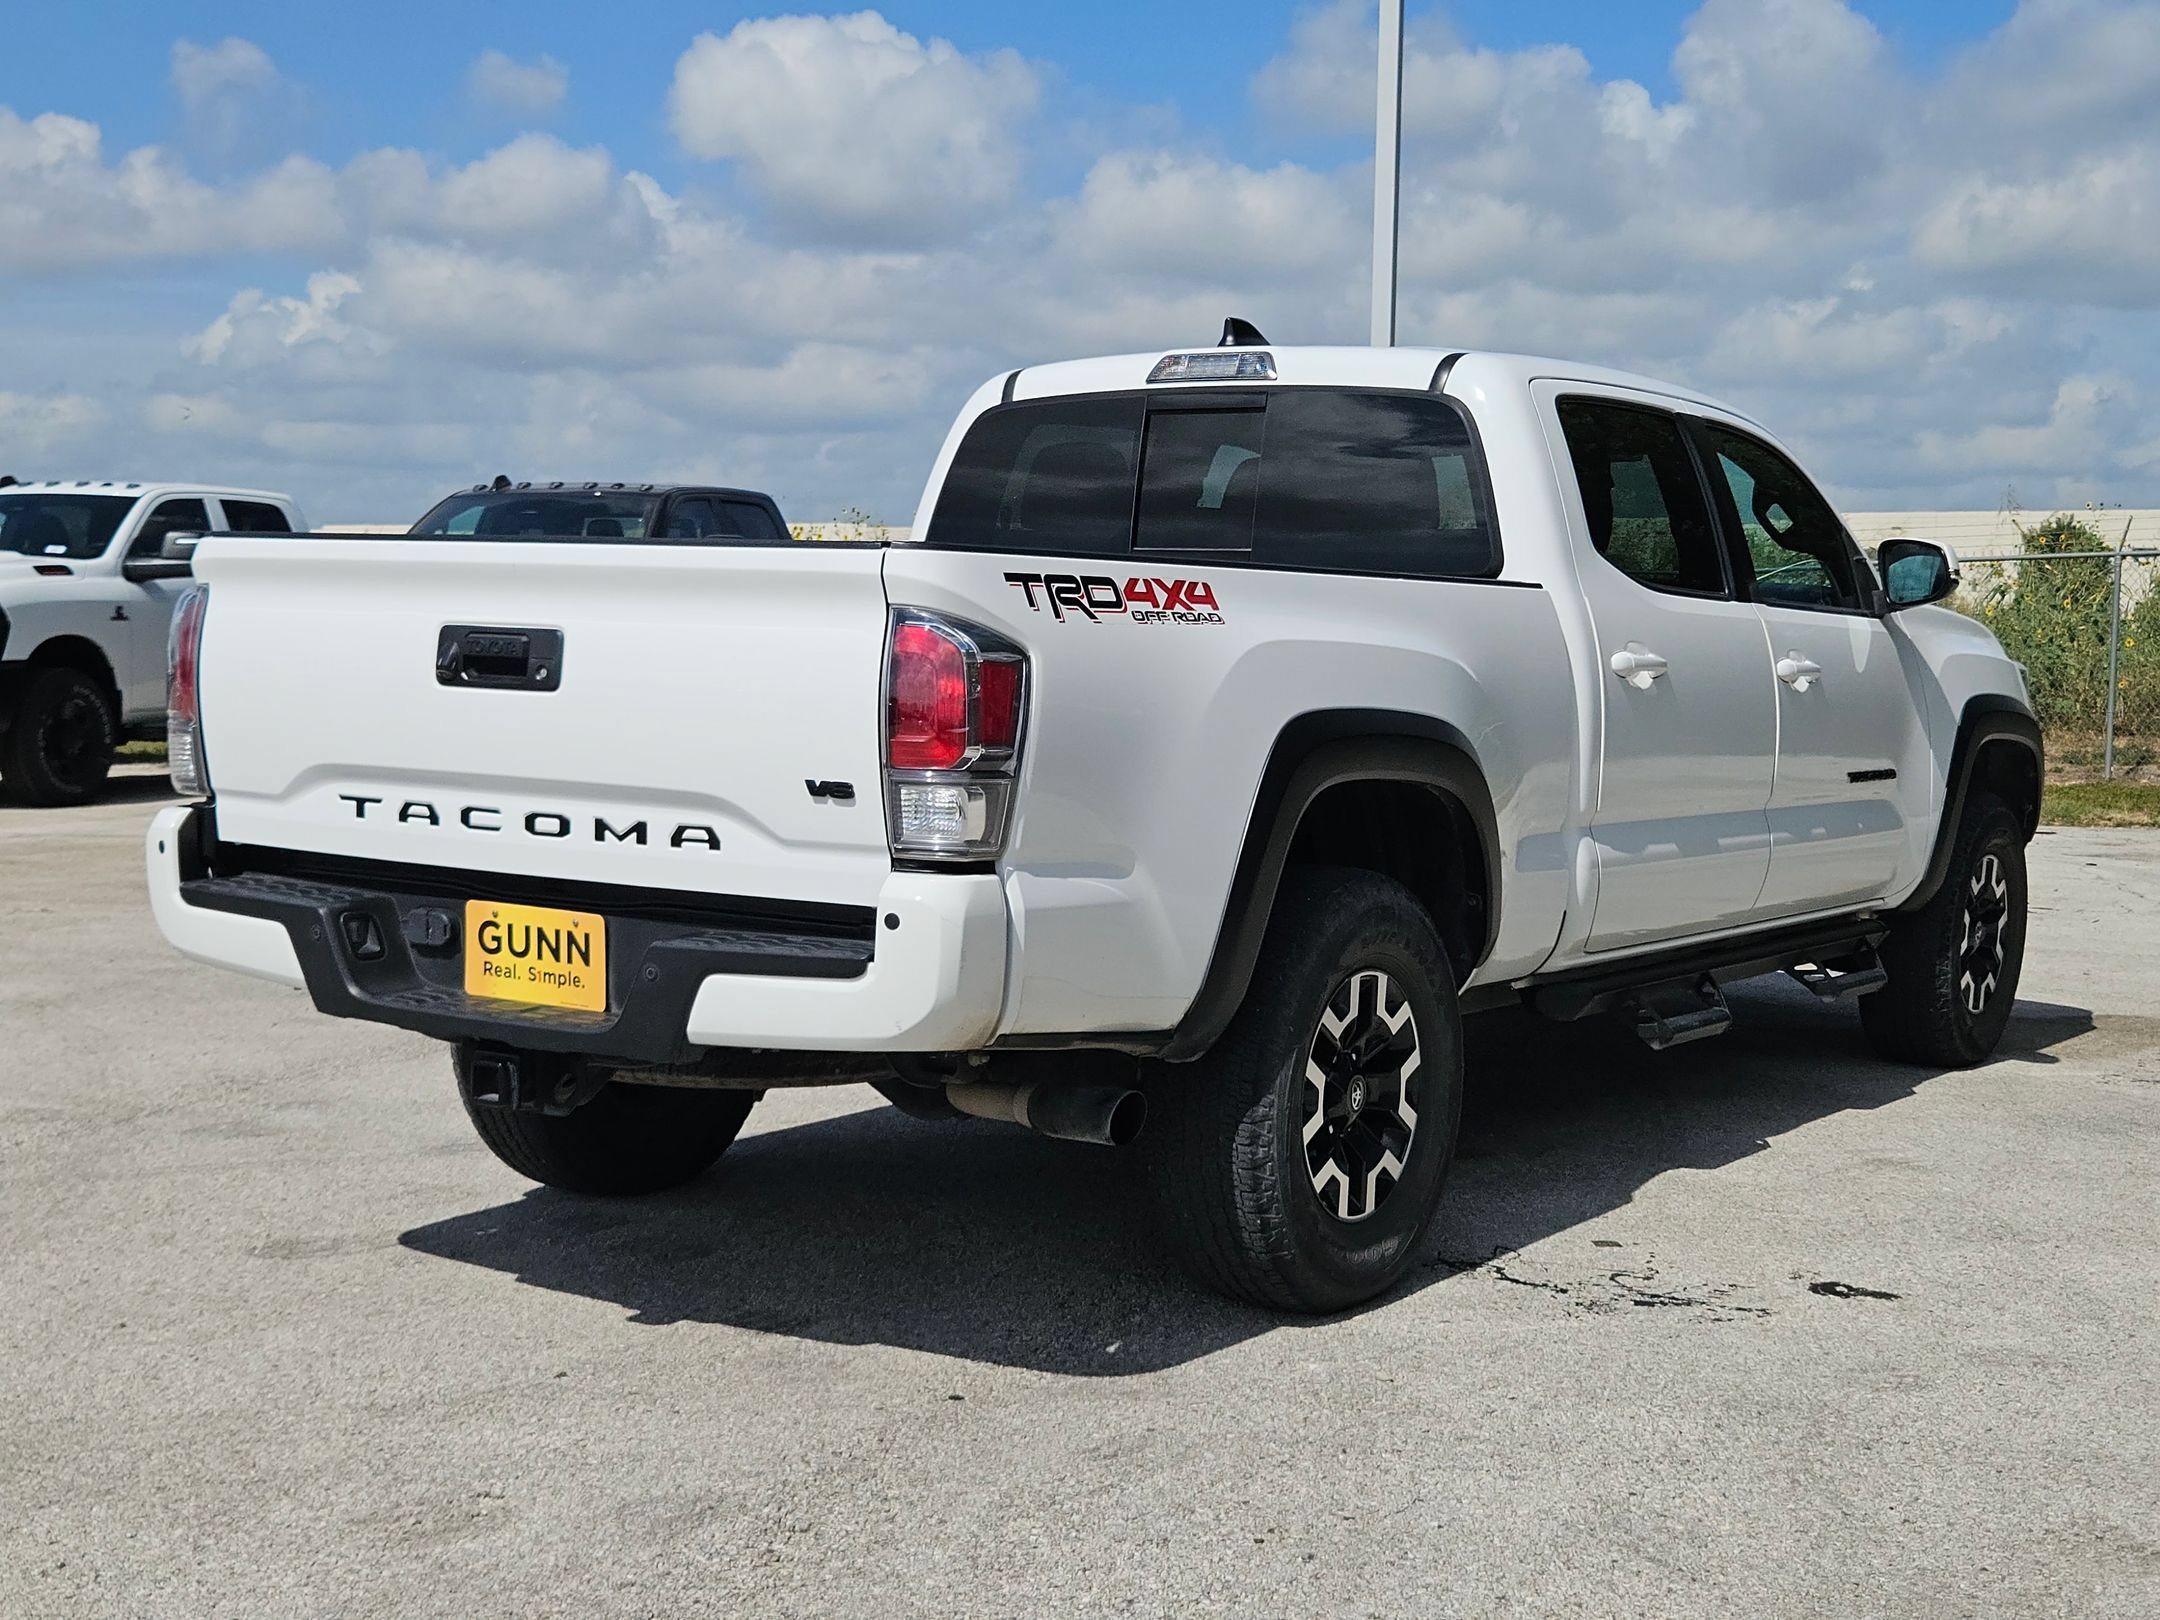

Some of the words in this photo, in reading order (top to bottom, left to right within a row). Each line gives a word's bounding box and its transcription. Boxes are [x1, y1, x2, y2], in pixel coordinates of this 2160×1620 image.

[1003, 572, 1127, 624] TRD
[1131, 610, 1170, 624] OFF
[1171, 611, 1226, 625] ROAD
[804, 779, 856, 800] V6
[339, 794, 721, 851] TACOMA
[478, 919, 591, 968] GUNN
[483, 961, 521, 981] Real.
